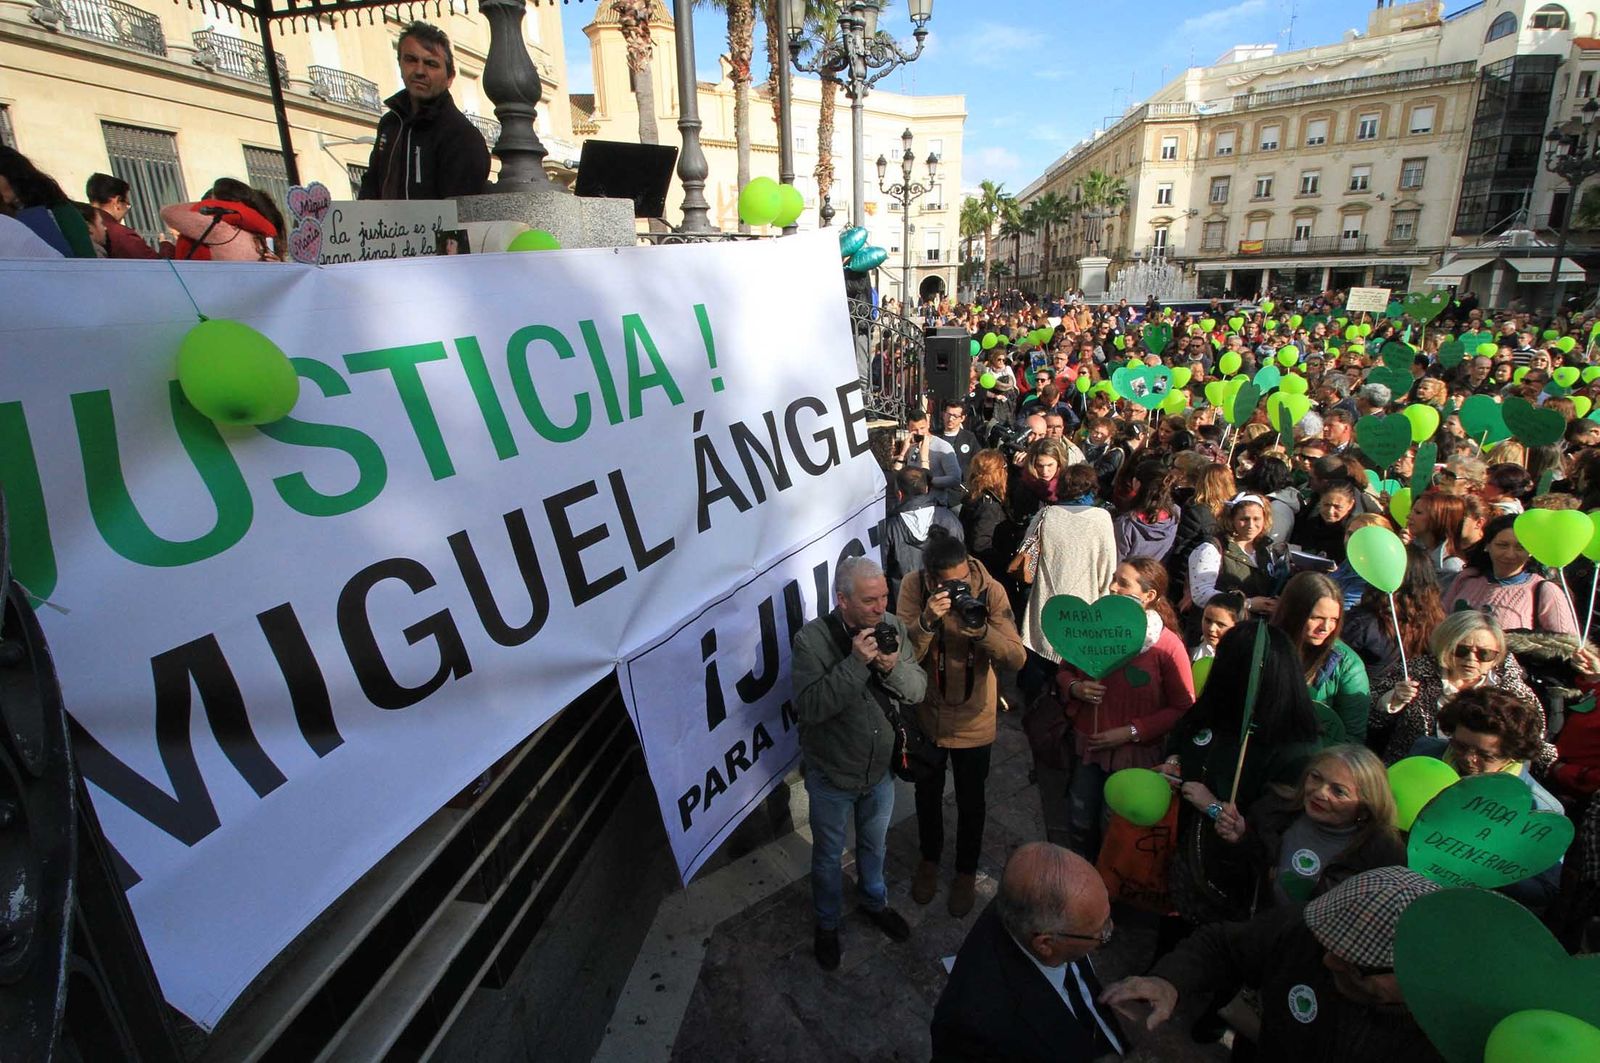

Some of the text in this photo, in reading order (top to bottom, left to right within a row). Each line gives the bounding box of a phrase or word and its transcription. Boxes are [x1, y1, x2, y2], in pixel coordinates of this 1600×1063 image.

[329, 209, 351, 245] La
[358, 218, 410, 248] justicia
[413, 223, 426, 235] es
[402, 240, 417, 258] de
[0, 313, 685, 610] JUSTICIA
[1064, 625, 1133, 639] ALMONTEÑA
[1079, 644, 1128, 657] VALIENTE
[65, 469, 676, 892] MIGUEL
[677, 722, 775, 832] PARA
[1461, 796, 1553, 843] NADA VA
[1475, 827, 1492, 841] A
[1423, 831, 1529, 880] DETENERNOS
